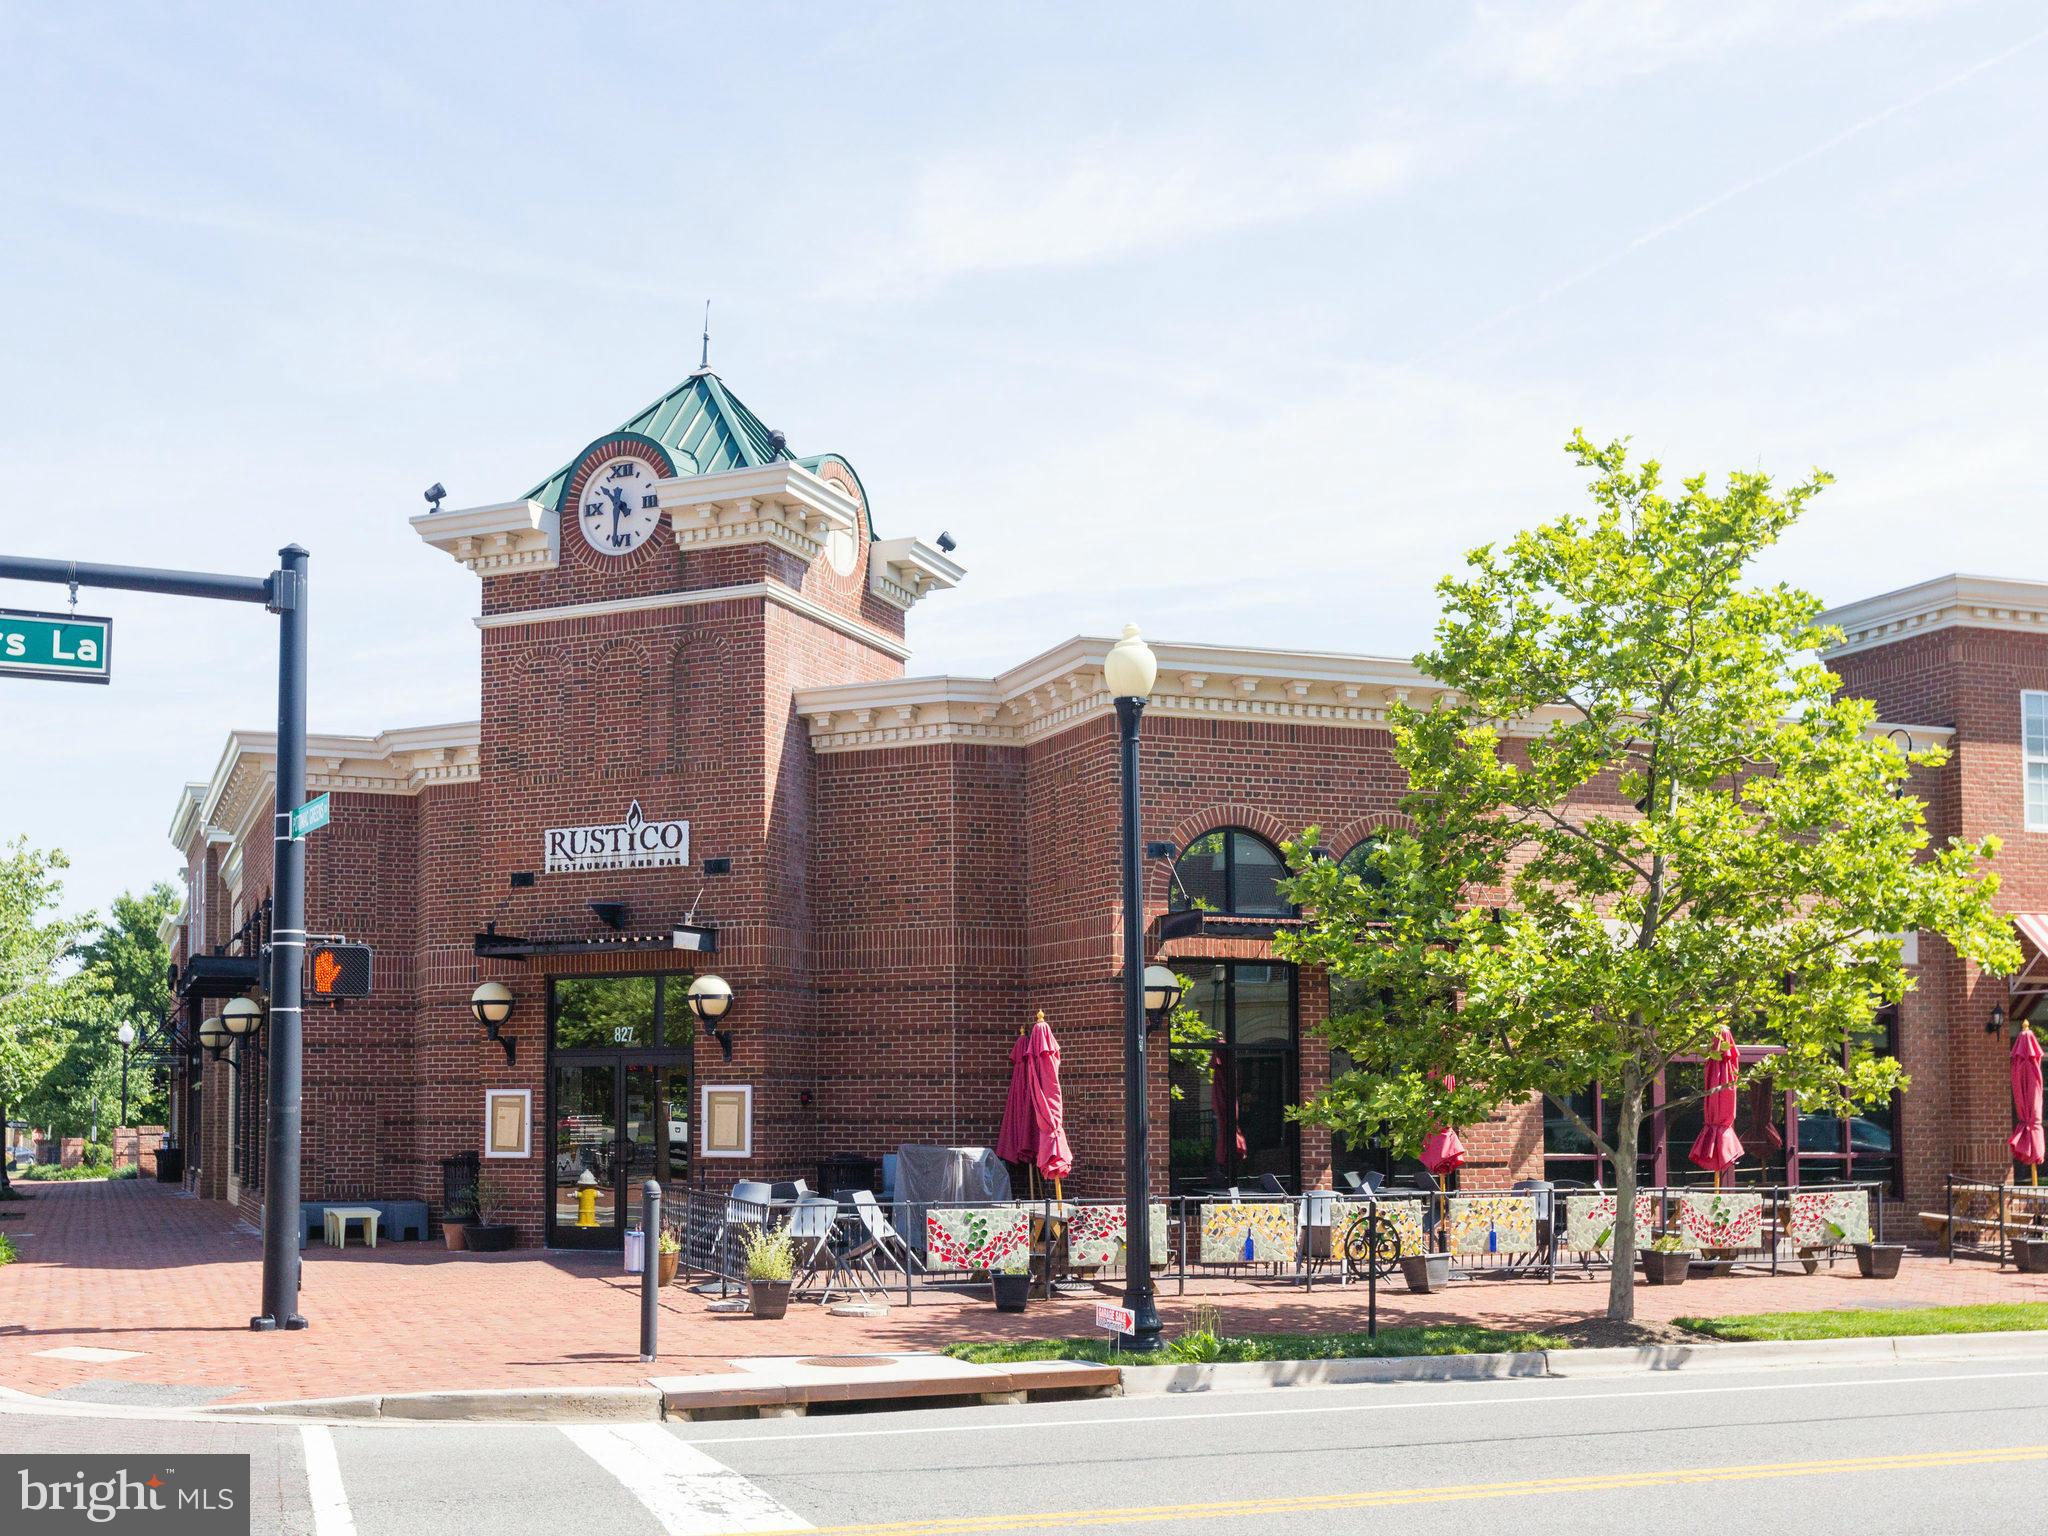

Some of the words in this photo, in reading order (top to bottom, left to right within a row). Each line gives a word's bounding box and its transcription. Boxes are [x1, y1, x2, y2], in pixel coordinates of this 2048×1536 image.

[609, 463, 634, 479] XII
[642, 494, 658, 509] III
[585, 502, 604, 517] IX
[0, 632, 26, 656] s
[53, 629, 97, 662] La
[549, 860, 624, 872] RESTAURANT
[630, 858, 652, 868] AND
[659, 857, 681, 866] BAR
[614, 1026, 634, 1042] 827
